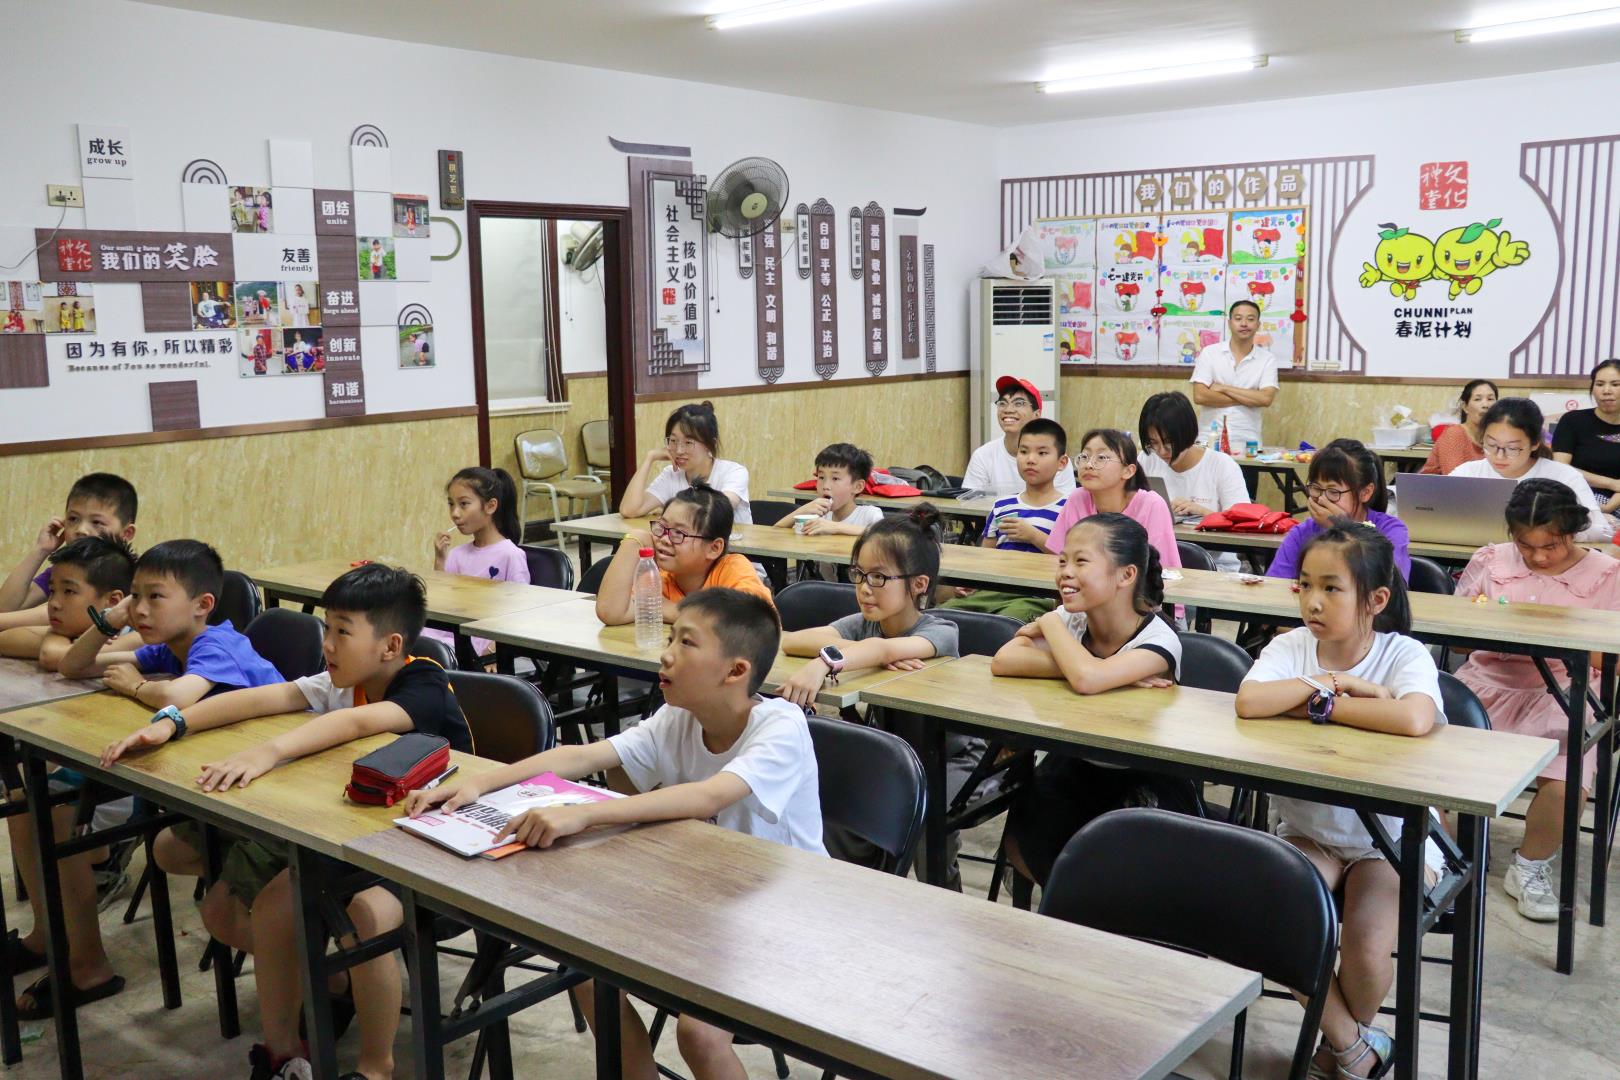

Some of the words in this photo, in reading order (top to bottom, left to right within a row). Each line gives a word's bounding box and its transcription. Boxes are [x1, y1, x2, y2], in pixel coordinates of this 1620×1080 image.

[89, 138, 124, 155] 成长
[114, 159, 127, 167] up
[1140, 174, 1296, 201] 我们的作品
[322, 201, 350, 216] 团结
[666, 205, 680, 283] 社会主义
[820, 221, 830, 250] 自由
[282, 248, 310, 263] 友善
[280, 264, 313, 273] friendly
[765, 257, 776, 286] 民主
[820, 258, 831, 286] 平等
[326, 291, 354, 306] 奋进
[683, 241, 697, 340] 核心价值观
[821, 294, 832, 322] 公正
[1394, 308, 1448, 318] CHUNNI
[1450, 307, 1473, 315] PLAN
[1396, 320, 1471, 338] 春泥计划
[329, 338, 357, 353] 创新
[822, 330, 833, 358] 法治
[331, 382, 359, 397] 和谐
